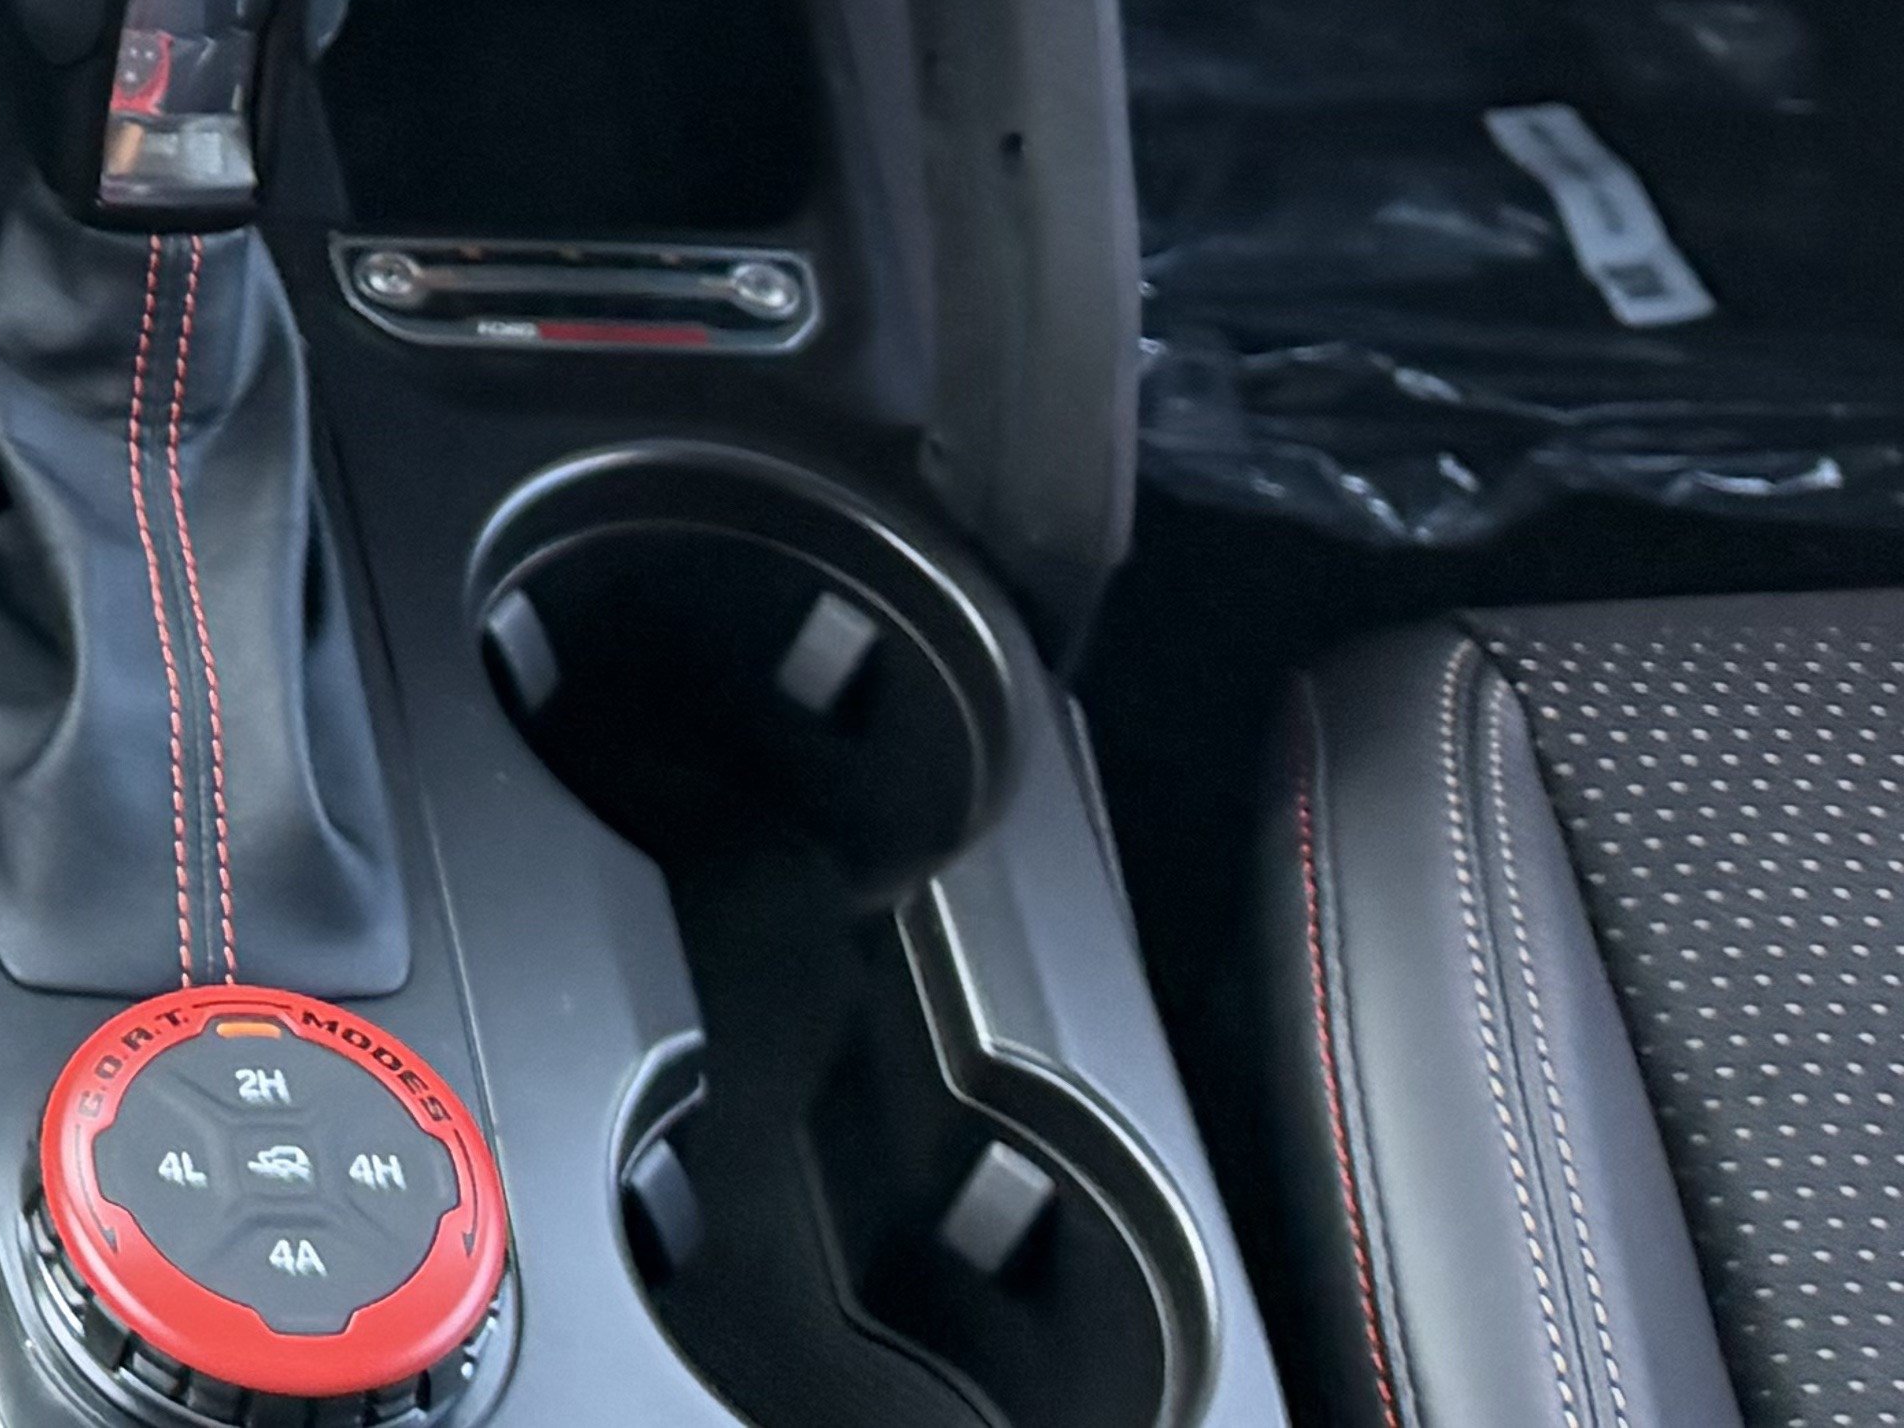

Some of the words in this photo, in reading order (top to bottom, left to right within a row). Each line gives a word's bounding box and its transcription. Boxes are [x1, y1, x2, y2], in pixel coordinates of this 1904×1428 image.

[299, 1010, 453, 1124] MODES
[235, 1068, 292, 1106] 2H
[157, 1151, 209, 1189] 4L
[348, 1153, 407, 1192] 4H
[268, 1239, 329, 1278] 4A
